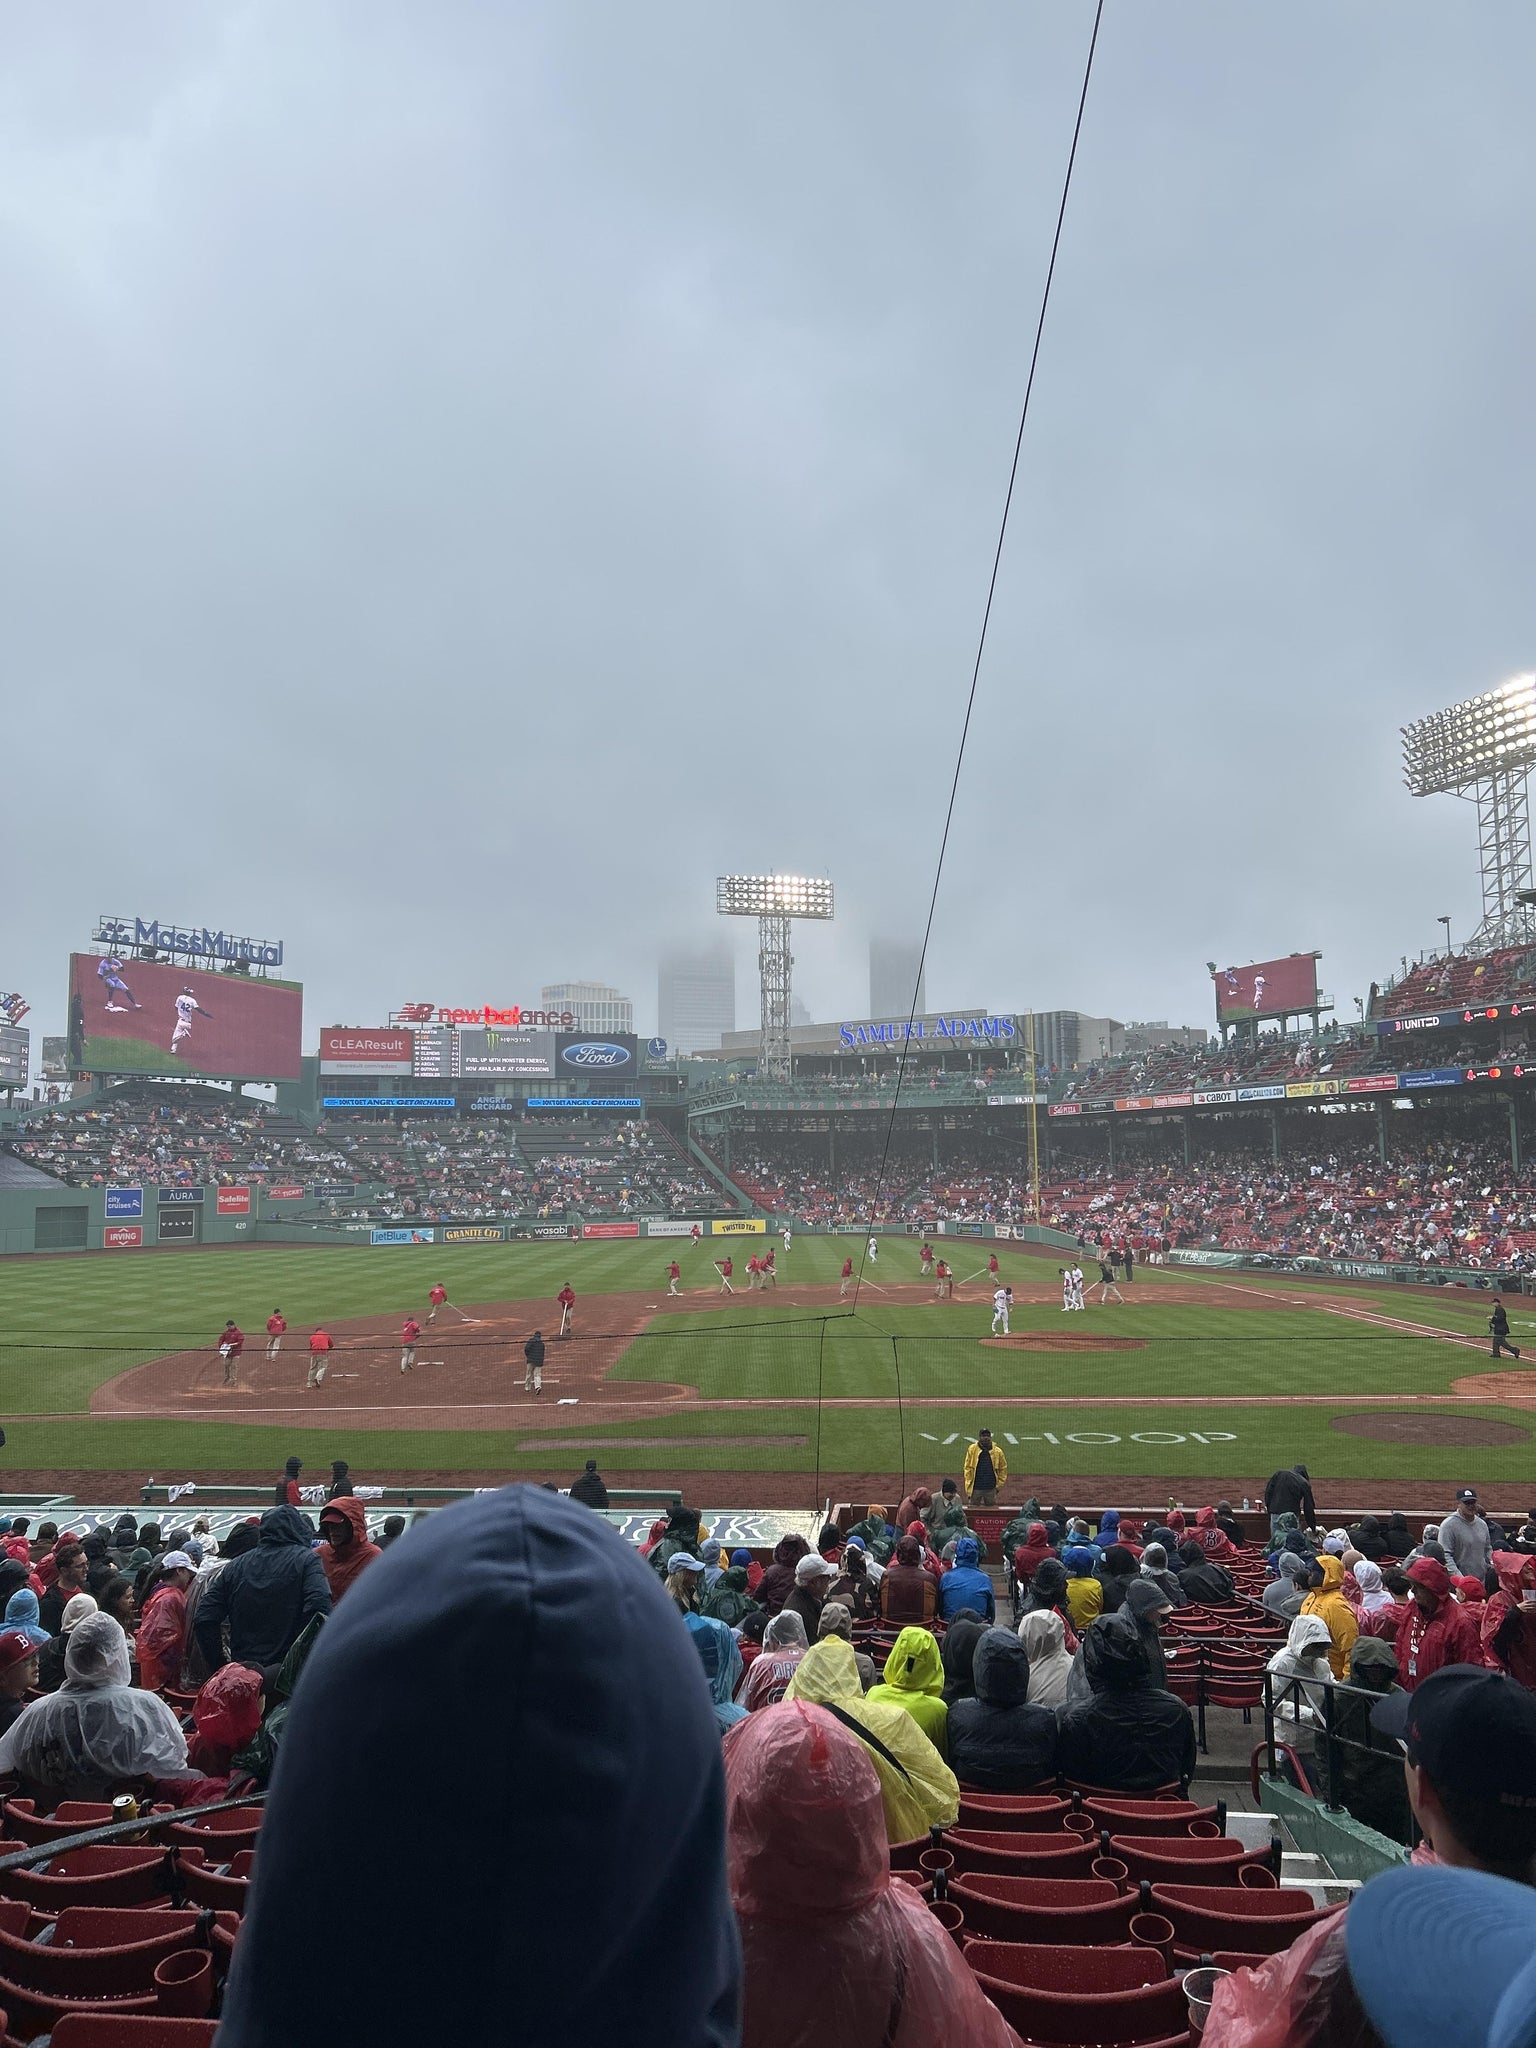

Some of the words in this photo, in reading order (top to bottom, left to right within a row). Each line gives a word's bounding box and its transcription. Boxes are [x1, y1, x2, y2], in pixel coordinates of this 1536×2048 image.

[136, 917, 283, 966] MassMutual
[181, 1002, 191, 1013] 42
[438, 1007, 481, 1023] new
[484, 1004, 574, 1025] balance
[1404, 1016, 1440, 1030] UNITED
[840, 1022, 927, 1048] SAMUEL
[933, 1016, 1015, 1038] ADAMS
[330, 1040, 403, 1050] CLEAResult
[575, 1045, 618, 1064] Ford
[282, 1189, 304, 1197] TICKET
[446, 1229, 482, 1240] GRANITE
[484, 1228, 502, 1238] CITY
[534, 1226, 568, 1235] wasabi
[722, 1224, 745, 1232] TWISTED
[746, 1224, 756, 1232] TEA
[110, 1232, 136, 1240] IRVING
[375, 1231, 408, 1243] jetBlue
[919, 1432, 1238, 1444] WHOOP
[1204, 1529, 1218, 1549] B
[14, 1634, 29, 1649] B
